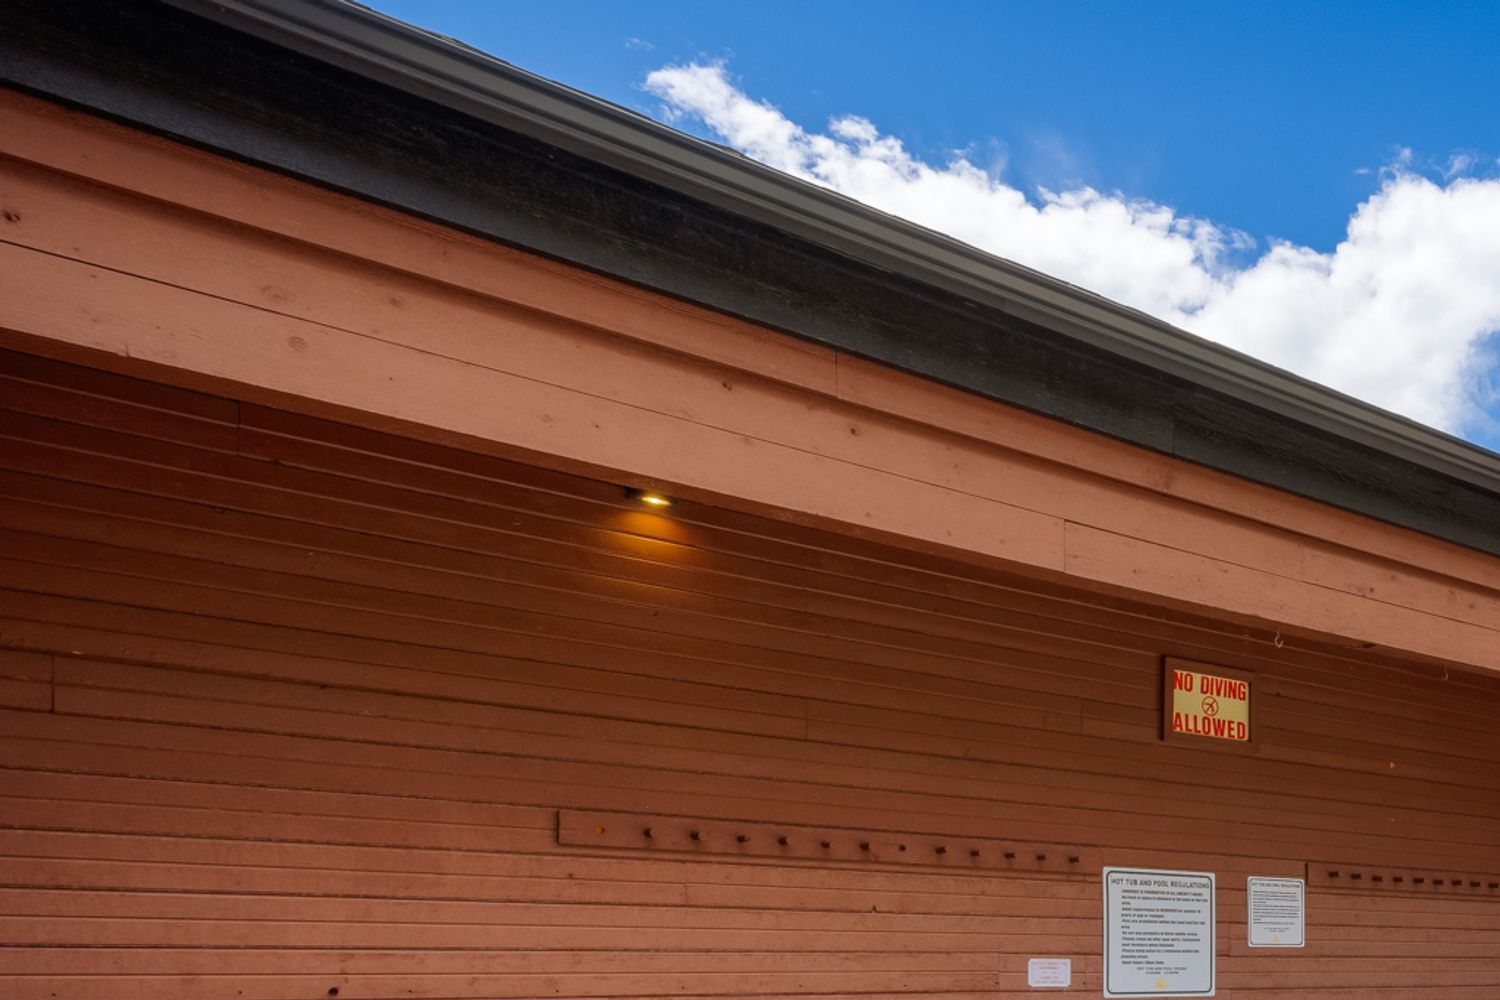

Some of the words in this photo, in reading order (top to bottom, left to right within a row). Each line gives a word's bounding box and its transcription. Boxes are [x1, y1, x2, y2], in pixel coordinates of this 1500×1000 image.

[1173, 671, 1193, 692] NO
[1200, 676, 1246, 702] DIVING
[1173, 711, 1246, 740] ALLOWED
[1170, 881, 1210, 889] REGULATIONS
